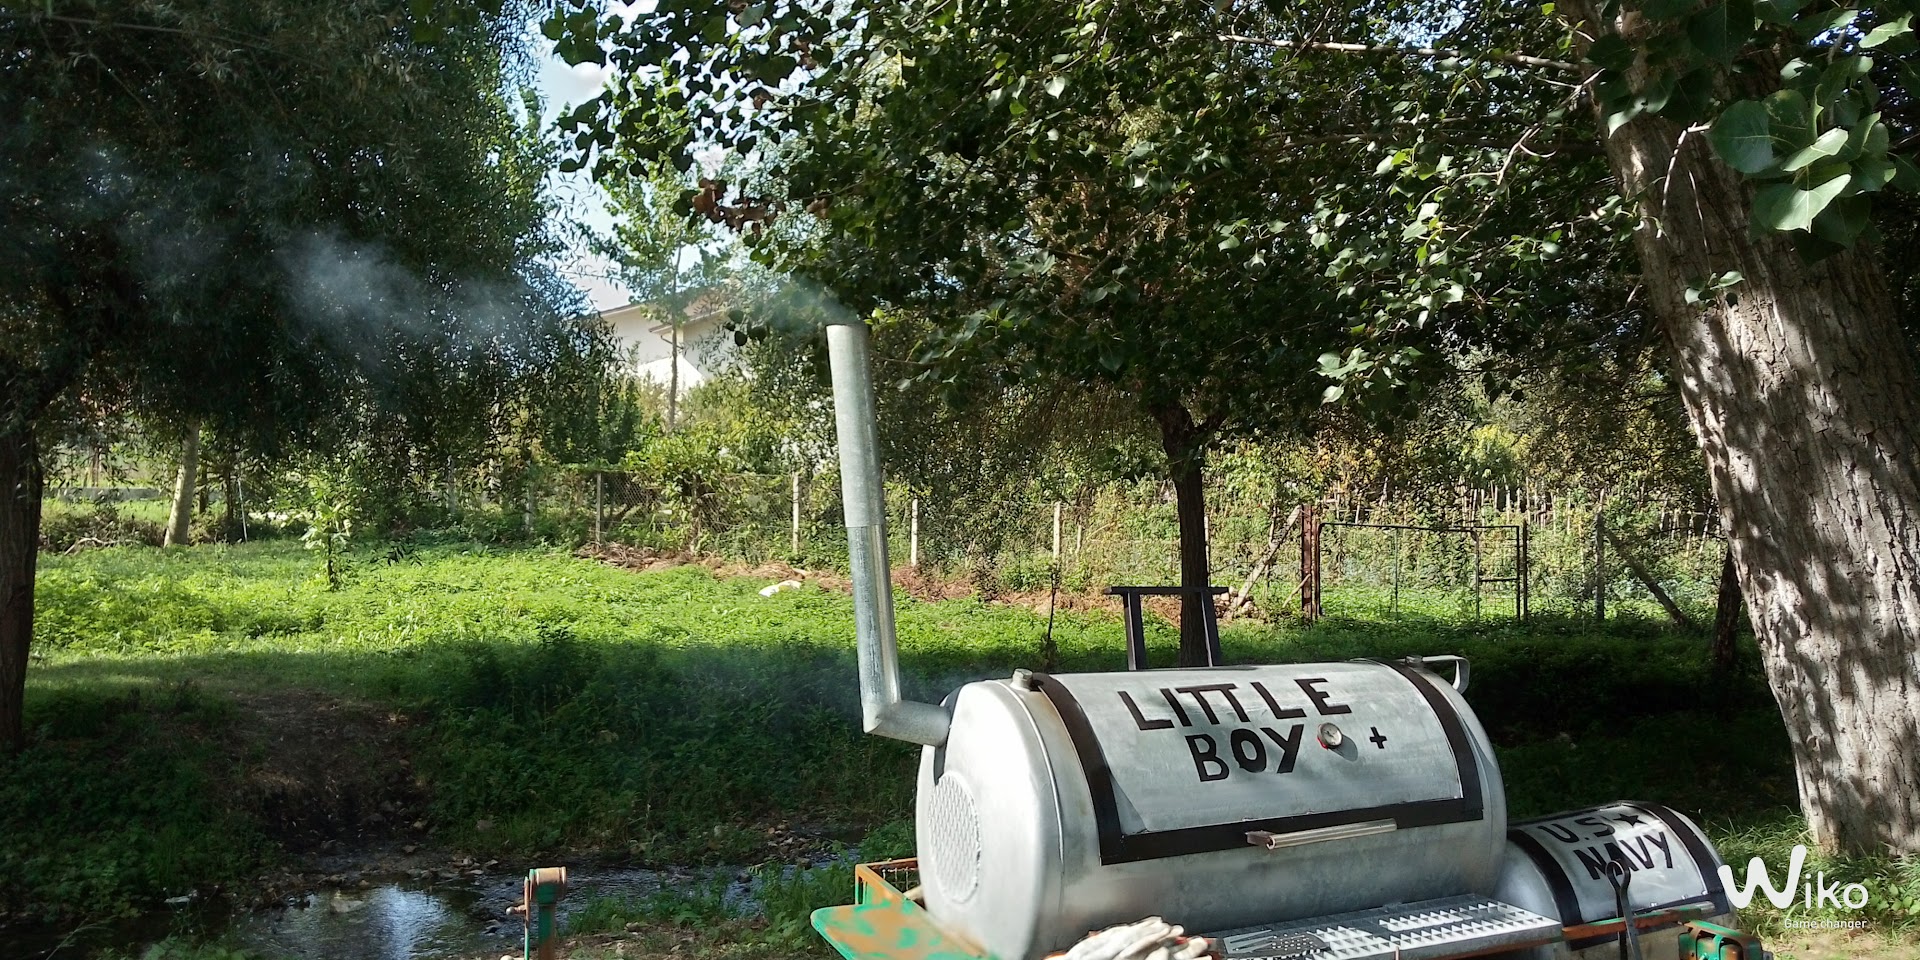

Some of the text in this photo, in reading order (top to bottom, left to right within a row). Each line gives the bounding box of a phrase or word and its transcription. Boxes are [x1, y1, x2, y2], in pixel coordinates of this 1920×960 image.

[1117, 678, 1352, 731] LITTLE
[1185, 724, 1304, 782] BOY
[1573, 831, 1673, 880] NAVY
